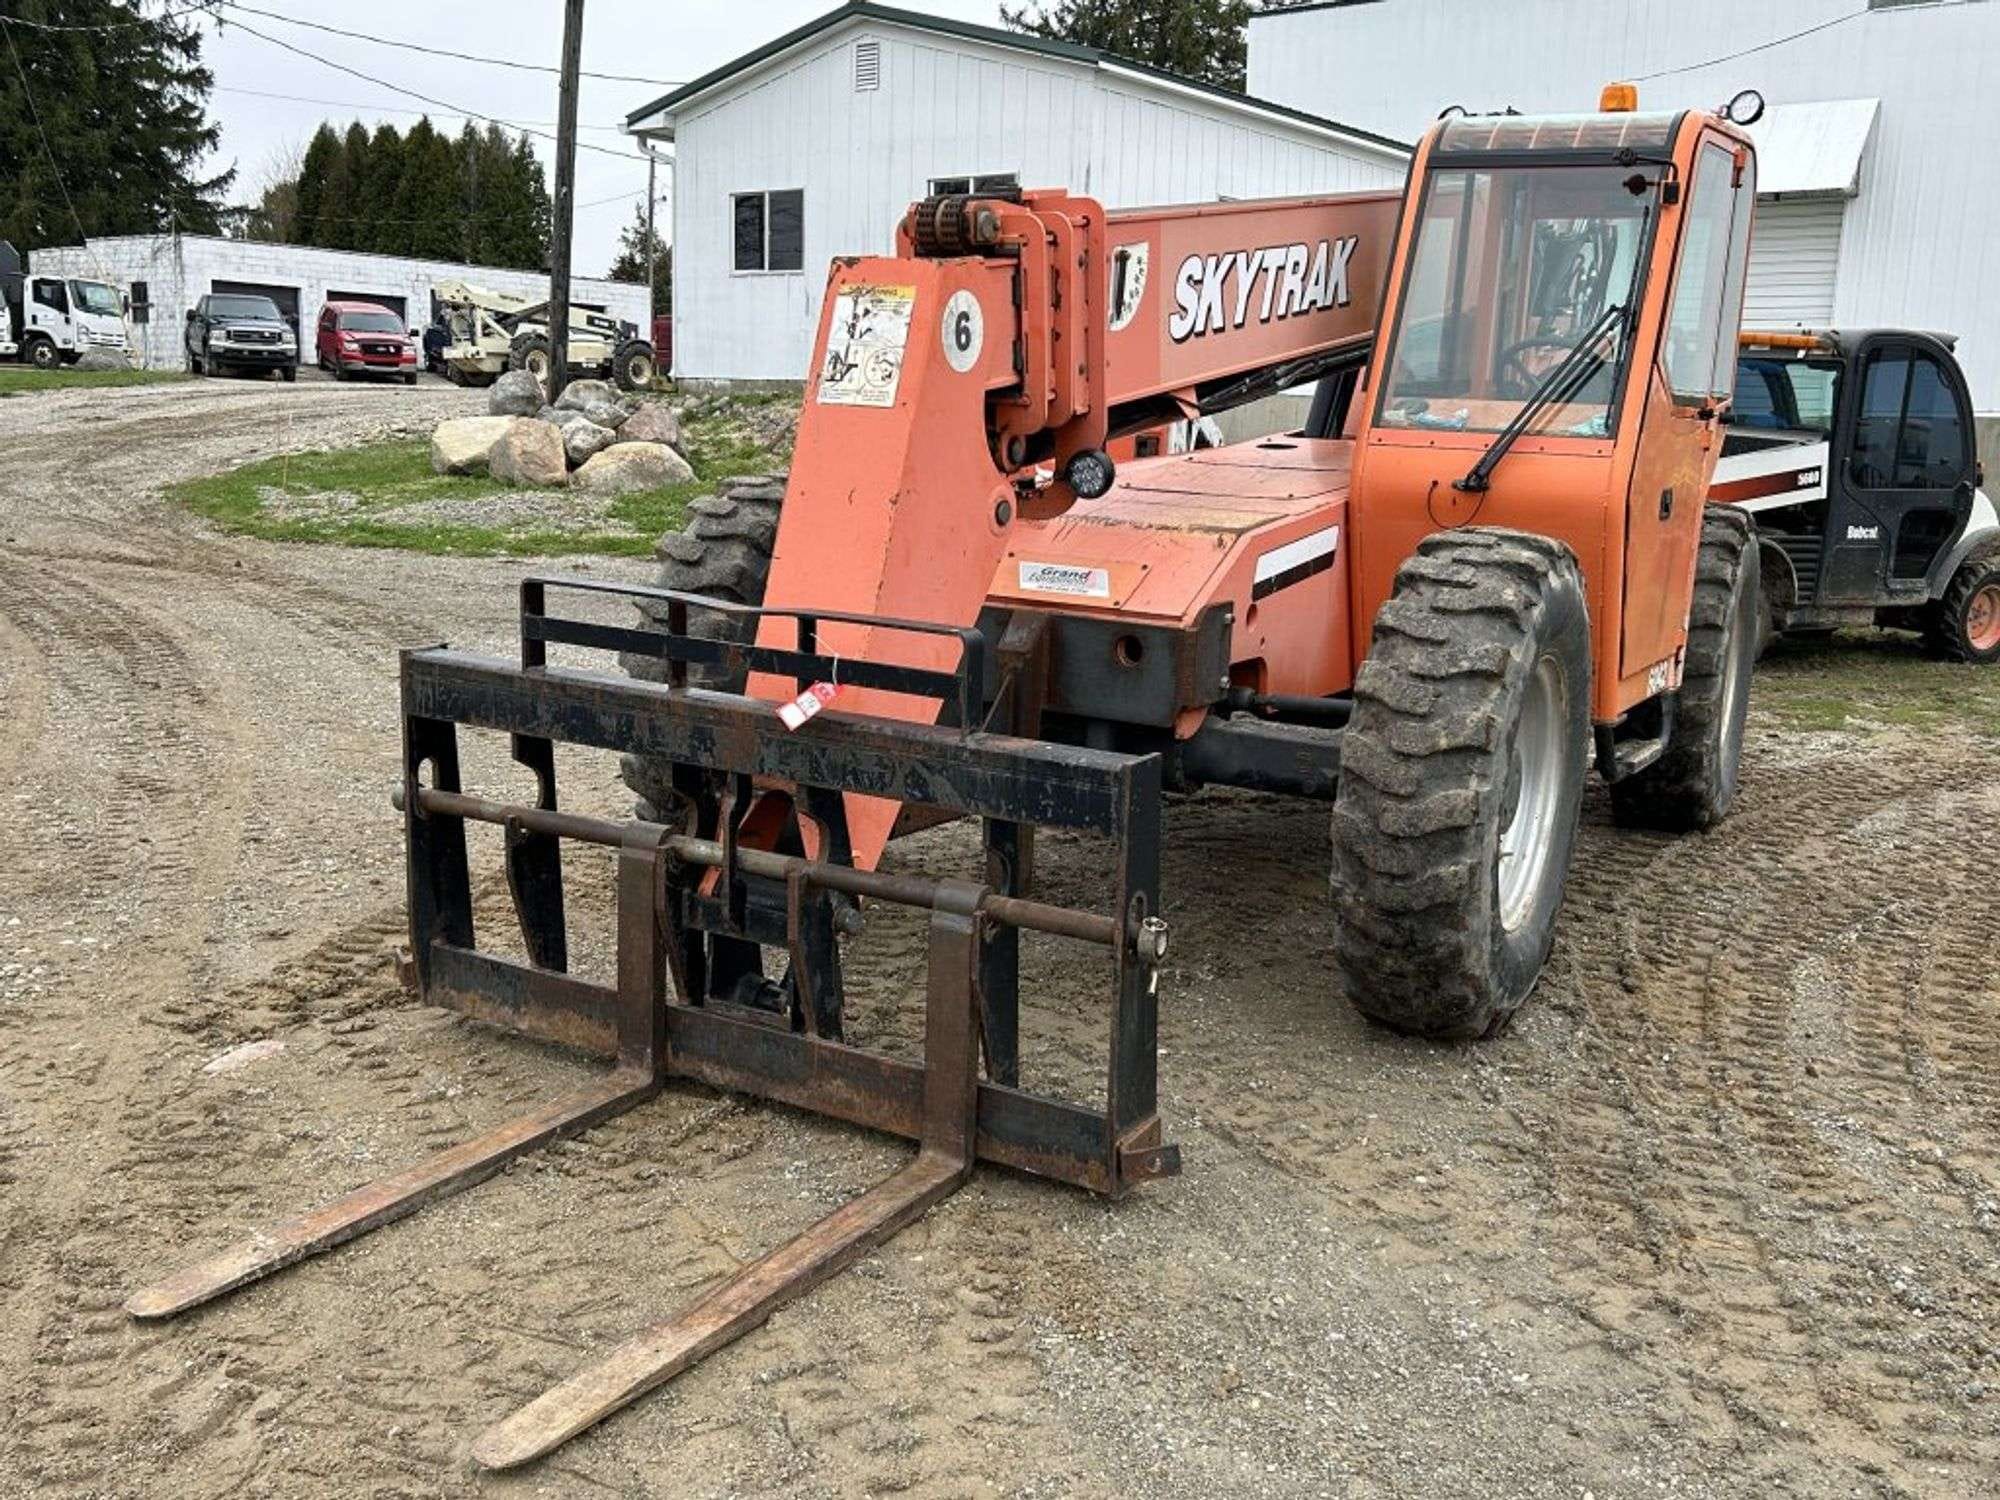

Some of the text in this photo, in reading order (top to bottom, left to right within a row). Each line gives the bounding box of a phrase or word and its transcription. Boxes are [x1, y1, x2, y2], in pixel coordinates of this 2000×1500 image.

[1169, 235, 1358, 343] SKYTRAK
[955, 311, 971, 351] 6
[1847, 525, 1878, 539] Bobcat
[1040, 566, 1092, 580] Grand
